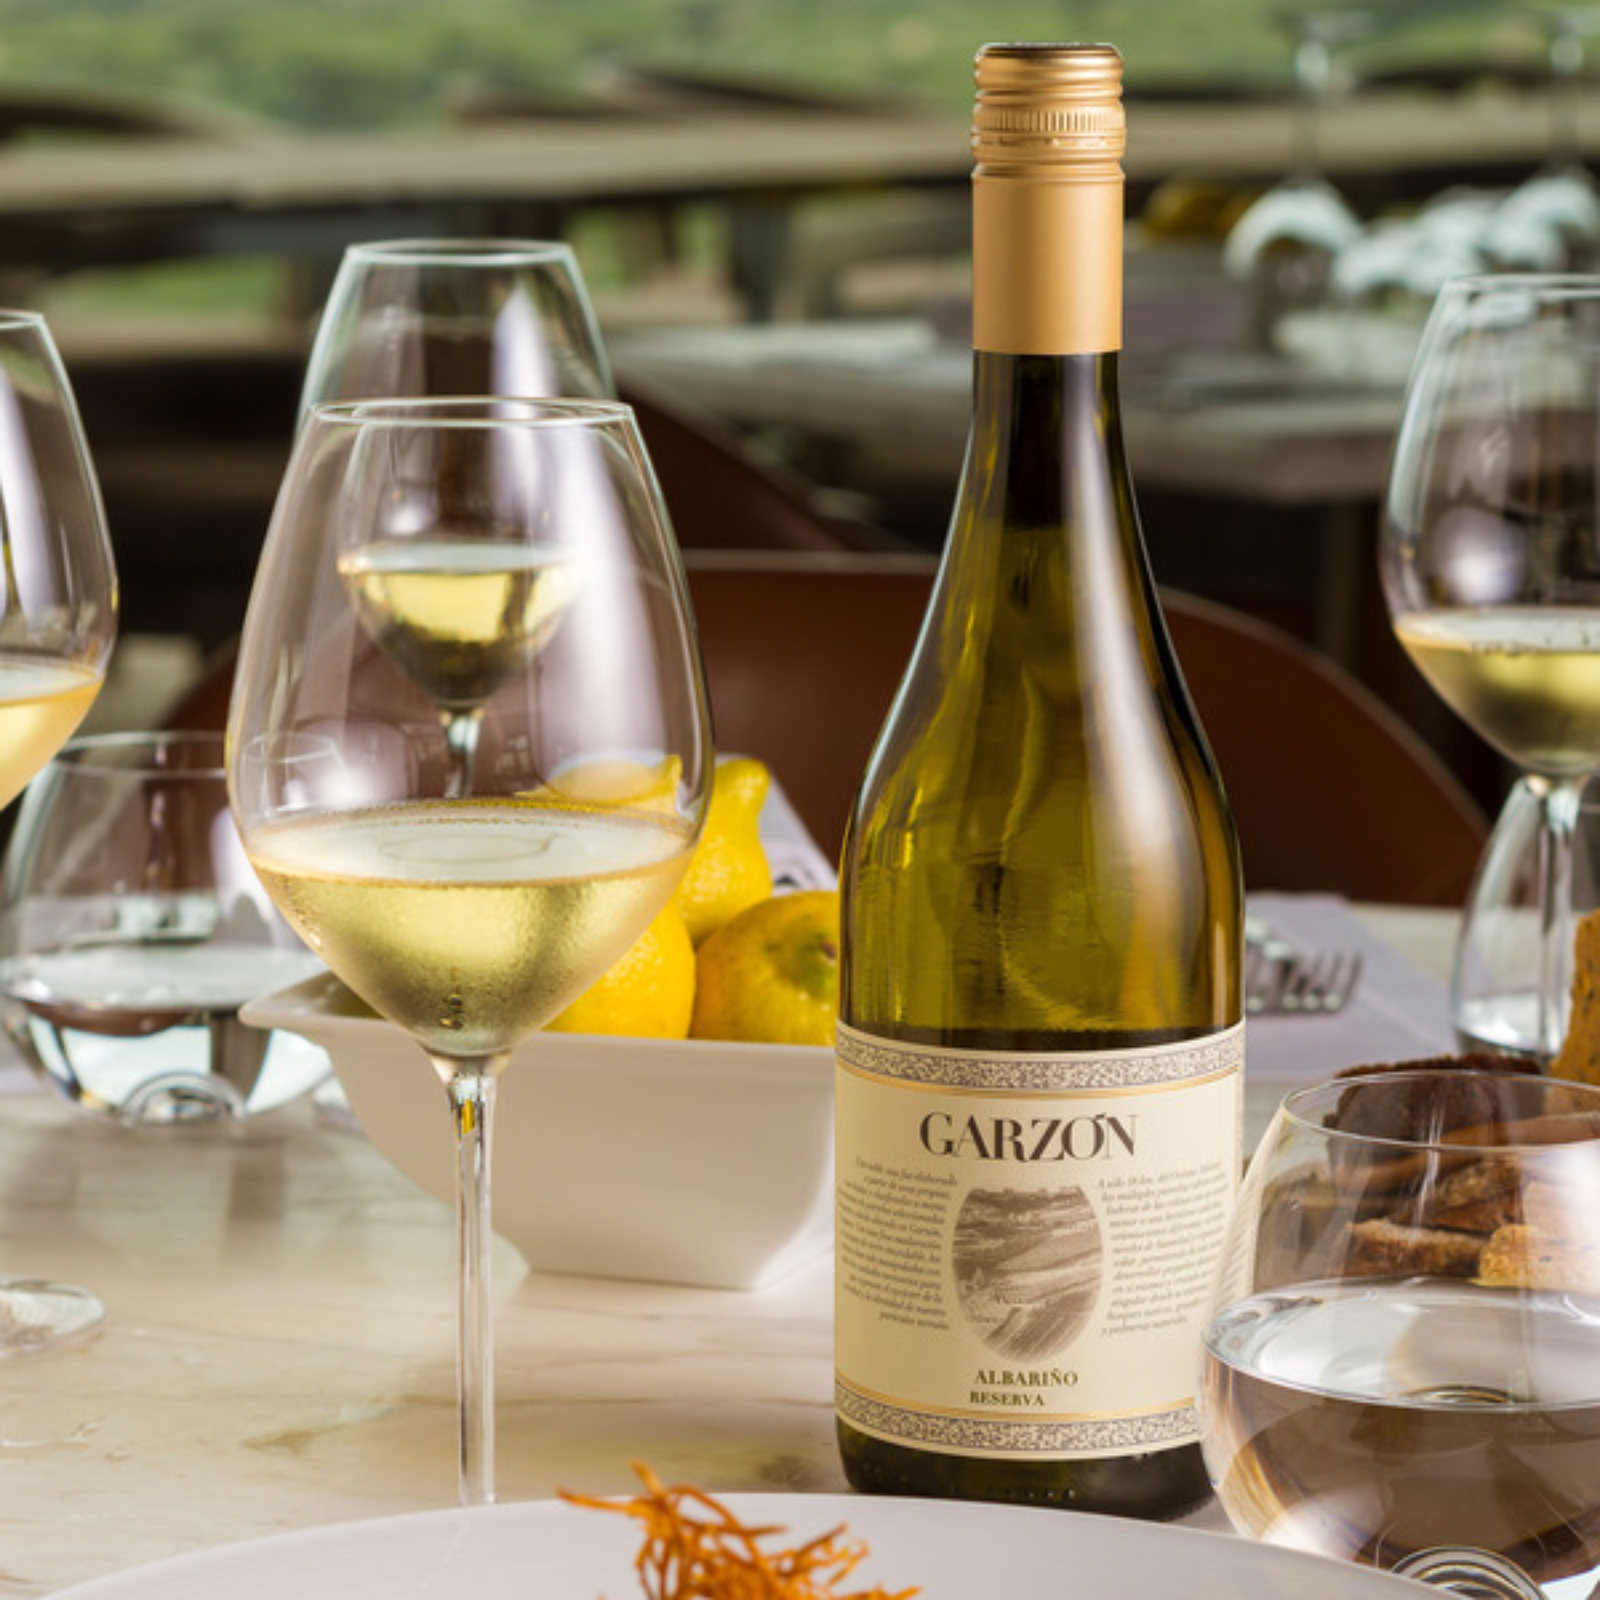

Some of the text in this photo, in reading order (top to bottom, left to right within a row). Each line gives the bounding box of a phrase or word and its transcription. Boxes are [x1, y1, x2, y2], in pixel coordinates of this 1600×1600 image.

[919, 1111, 1138, 1163] GARZÓN
[973, 1367, 1079, 1387] ALBARIÑO
[969, 1391, 1045, 1406] RESERVA
